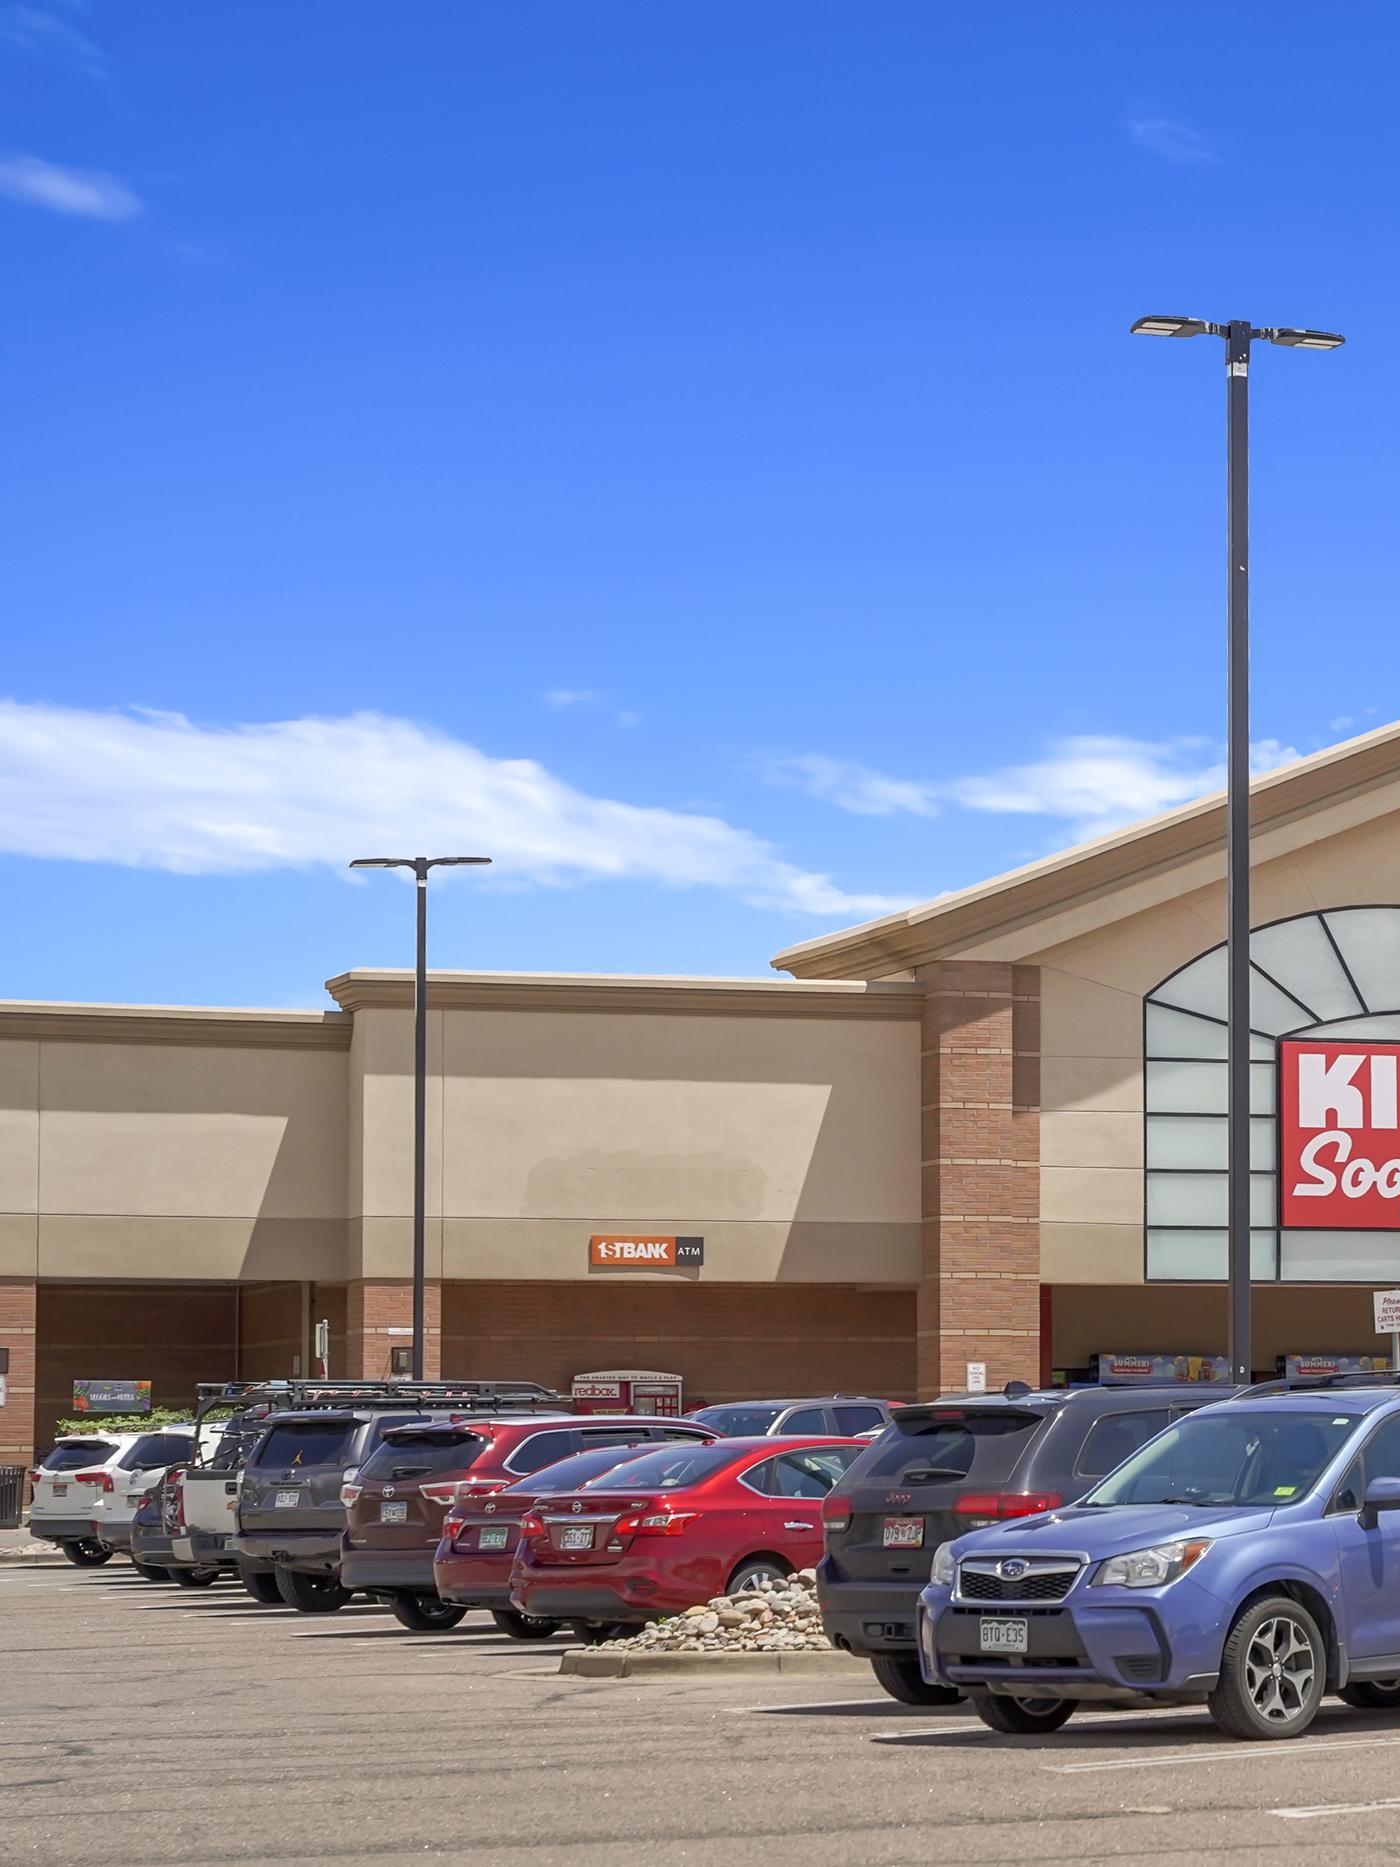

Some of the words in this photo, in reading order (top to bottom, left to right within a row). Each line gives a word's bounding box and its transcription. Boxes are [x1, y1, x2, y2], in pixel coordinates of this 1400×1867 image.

[677, 1247, 700, 1256] ATM
[1377, 1314, 1395, 1323] CARTS
[1300, 1360, 1336, 1368] SUMMER!
